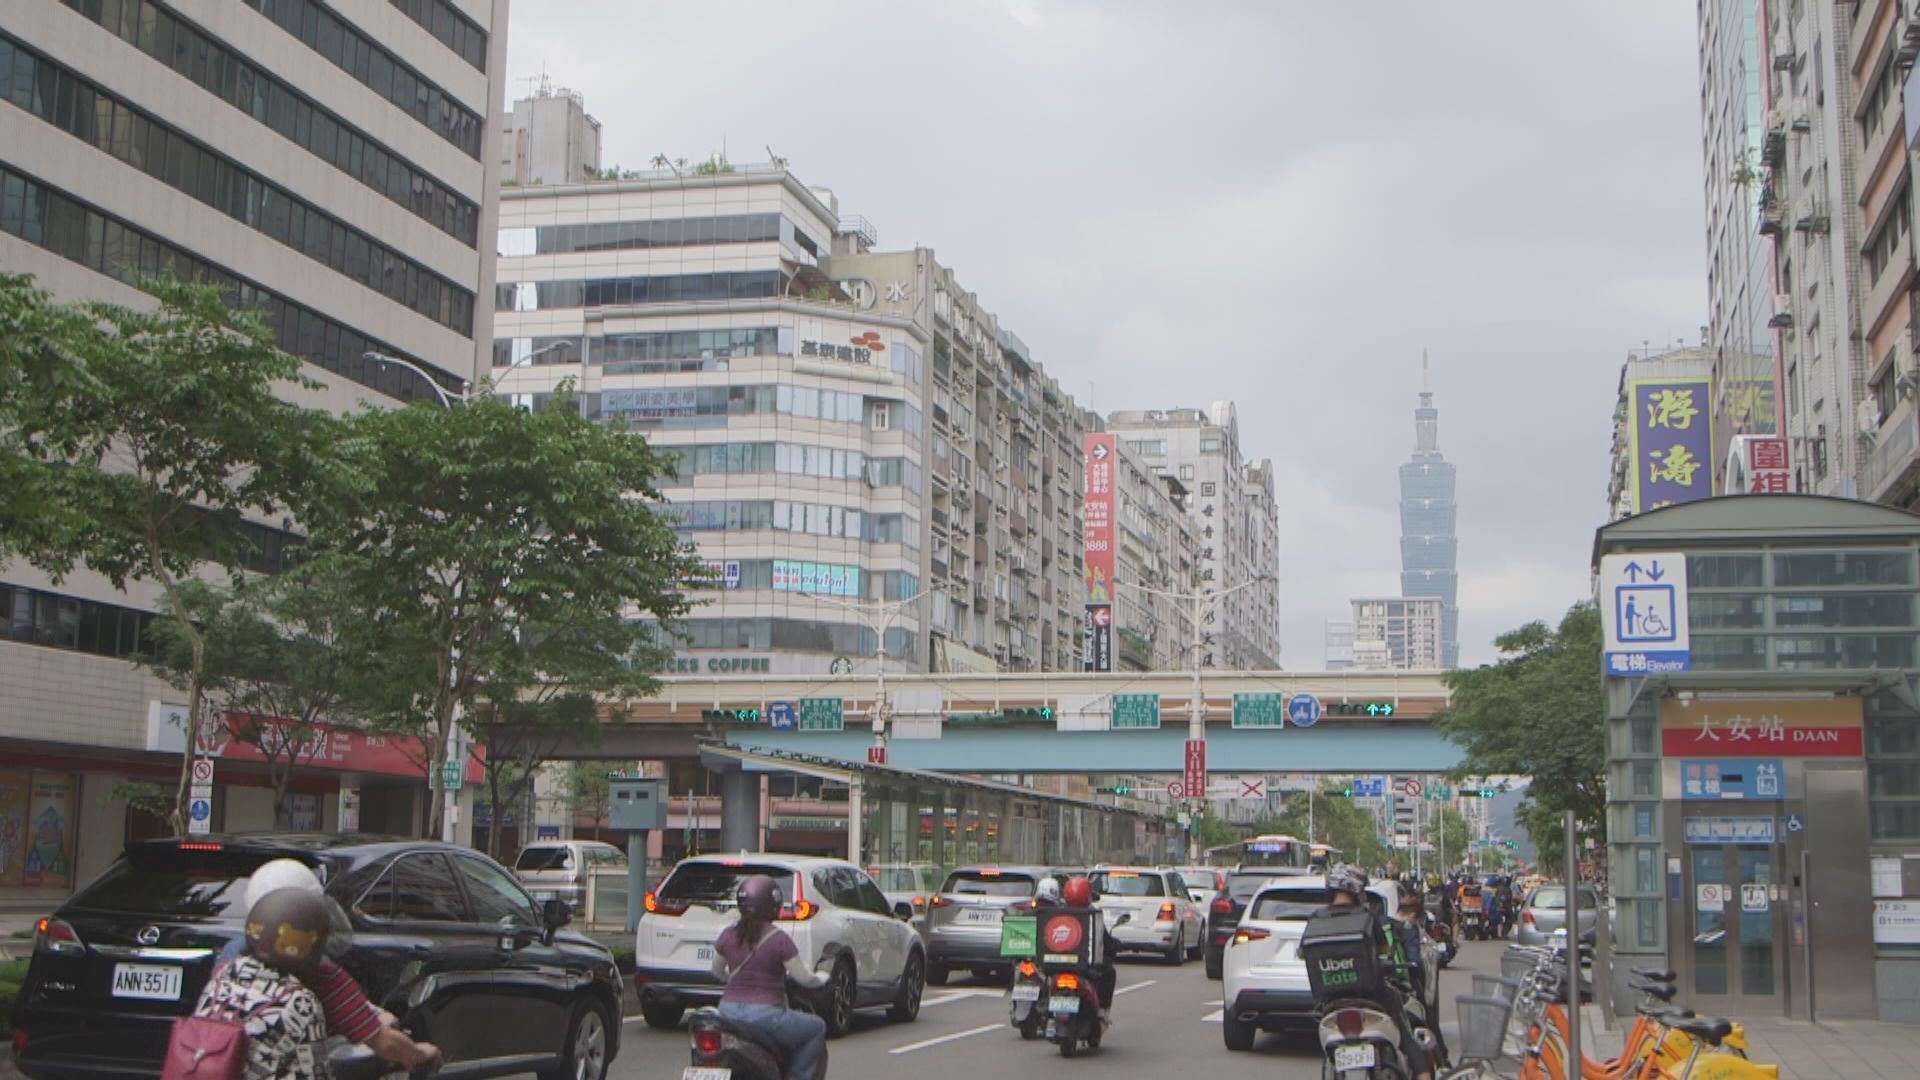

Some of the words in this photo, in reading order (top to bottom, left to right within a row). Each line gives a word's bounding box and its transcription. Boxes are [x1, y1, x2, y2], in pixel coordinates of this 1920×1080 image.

[708, 657, 770, 672] COFFEE
[1611, 653, 1647, 671] 電梯
[1648, 660, 1685, 672] Elevator
[1694, 714, 1785, 742] 大安站
[1793, 730, 1839, 742] DAAN
[1687, 779, 1720, 795] 電梯
[1318, 957, 1355, 971] Uber
[1321, 971, 1359, 986] Eats
